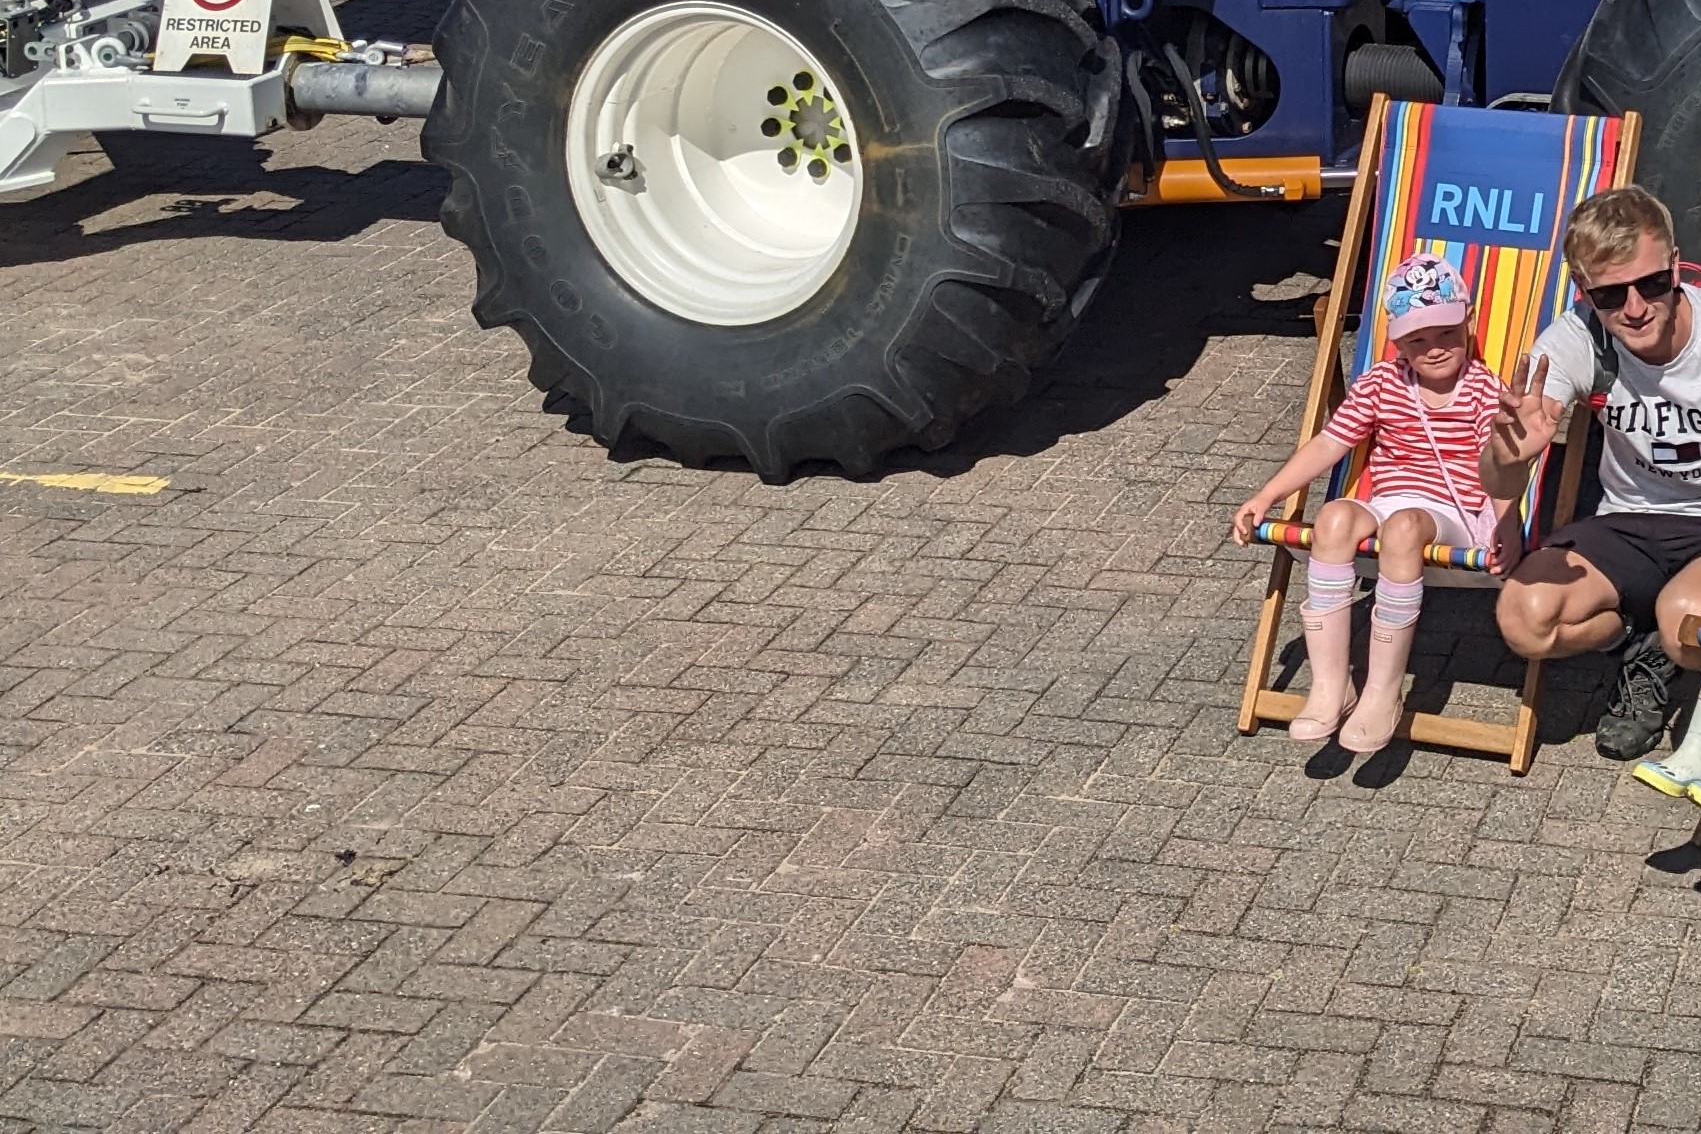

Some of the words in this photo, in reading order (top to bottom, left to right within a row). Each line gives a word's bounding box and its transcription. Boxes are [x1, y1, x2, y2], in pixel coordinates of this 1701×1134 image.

[165, 18, 262, 33] RESTRICTED
[189, 37, 231, 50] AREA
[1430, 182, 1544, 234] RNLI
[1635, 457, 1674, 478] NEW
